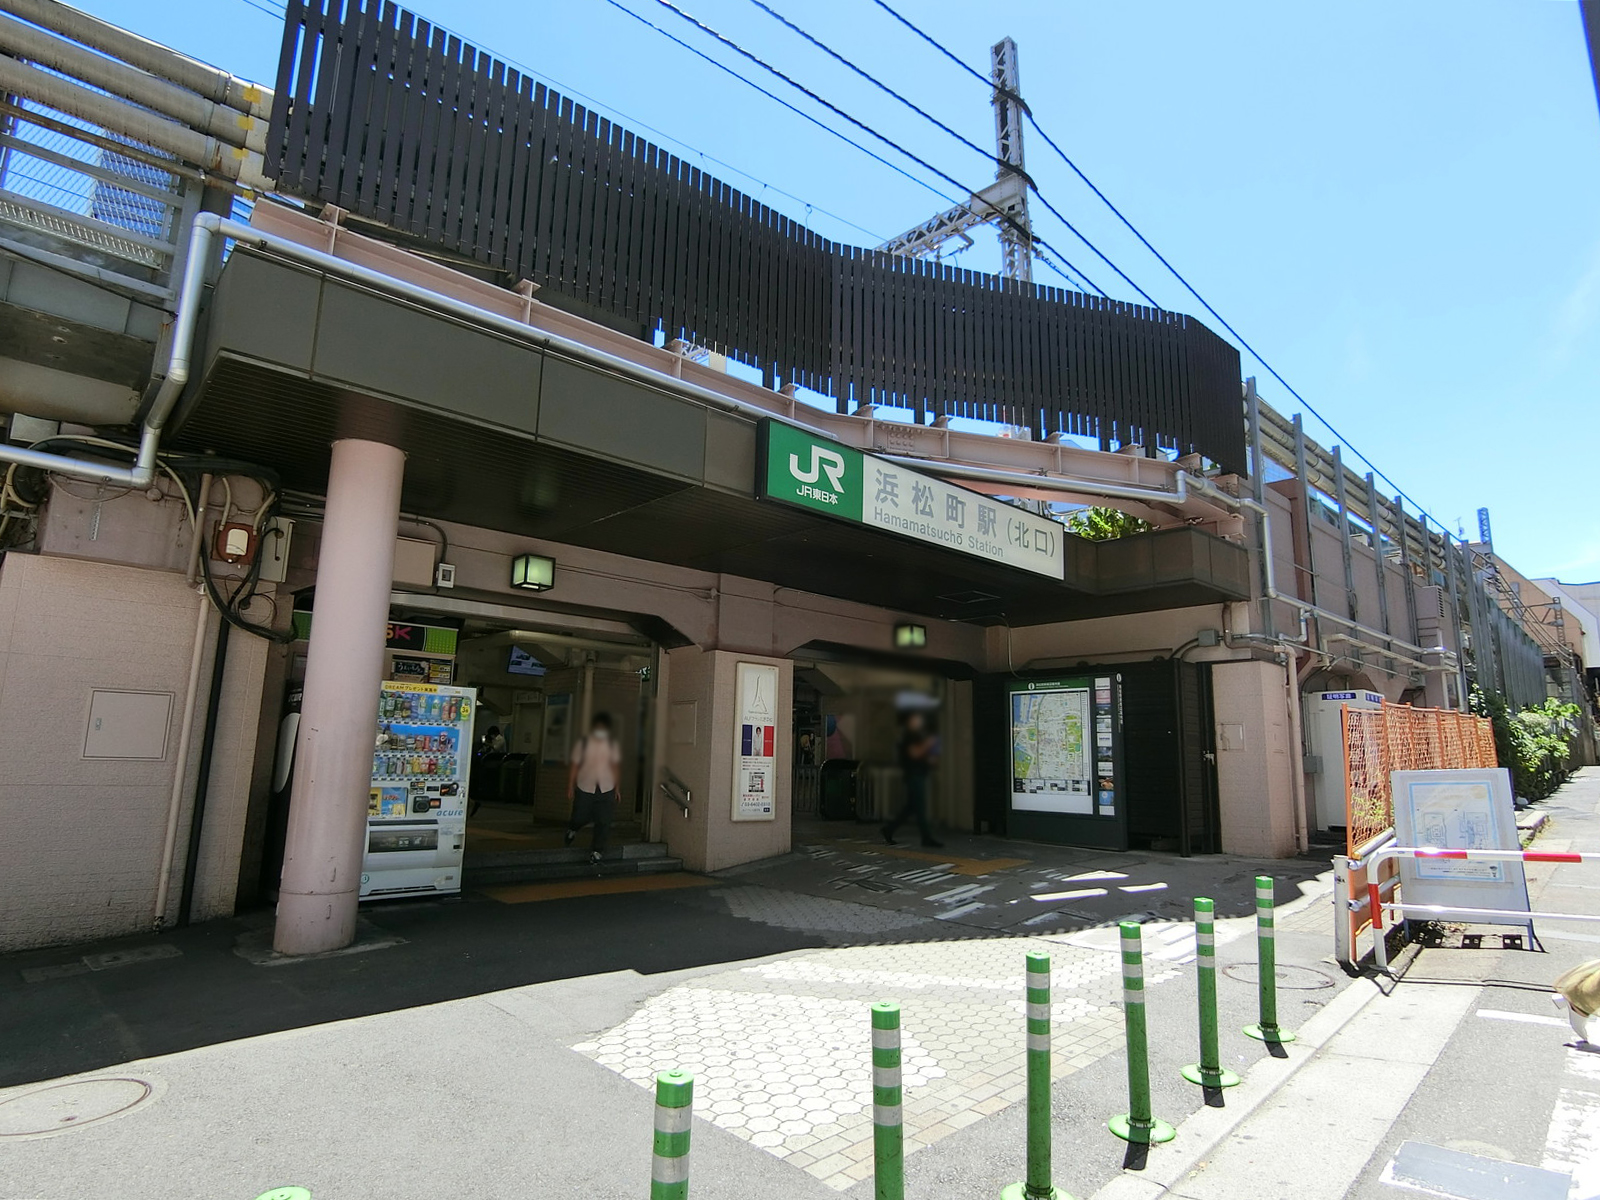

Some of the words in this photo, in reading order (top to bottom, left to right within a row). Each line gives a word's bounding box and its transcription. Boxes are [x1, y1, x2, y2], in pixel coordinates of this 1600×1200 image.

[789, 445, 845, 494] JR
[796, 484, 839, 506] JR東日本
[874, 506, 963, 545] Hamamatsuchō
[968, 535, 1004, 557] Station
